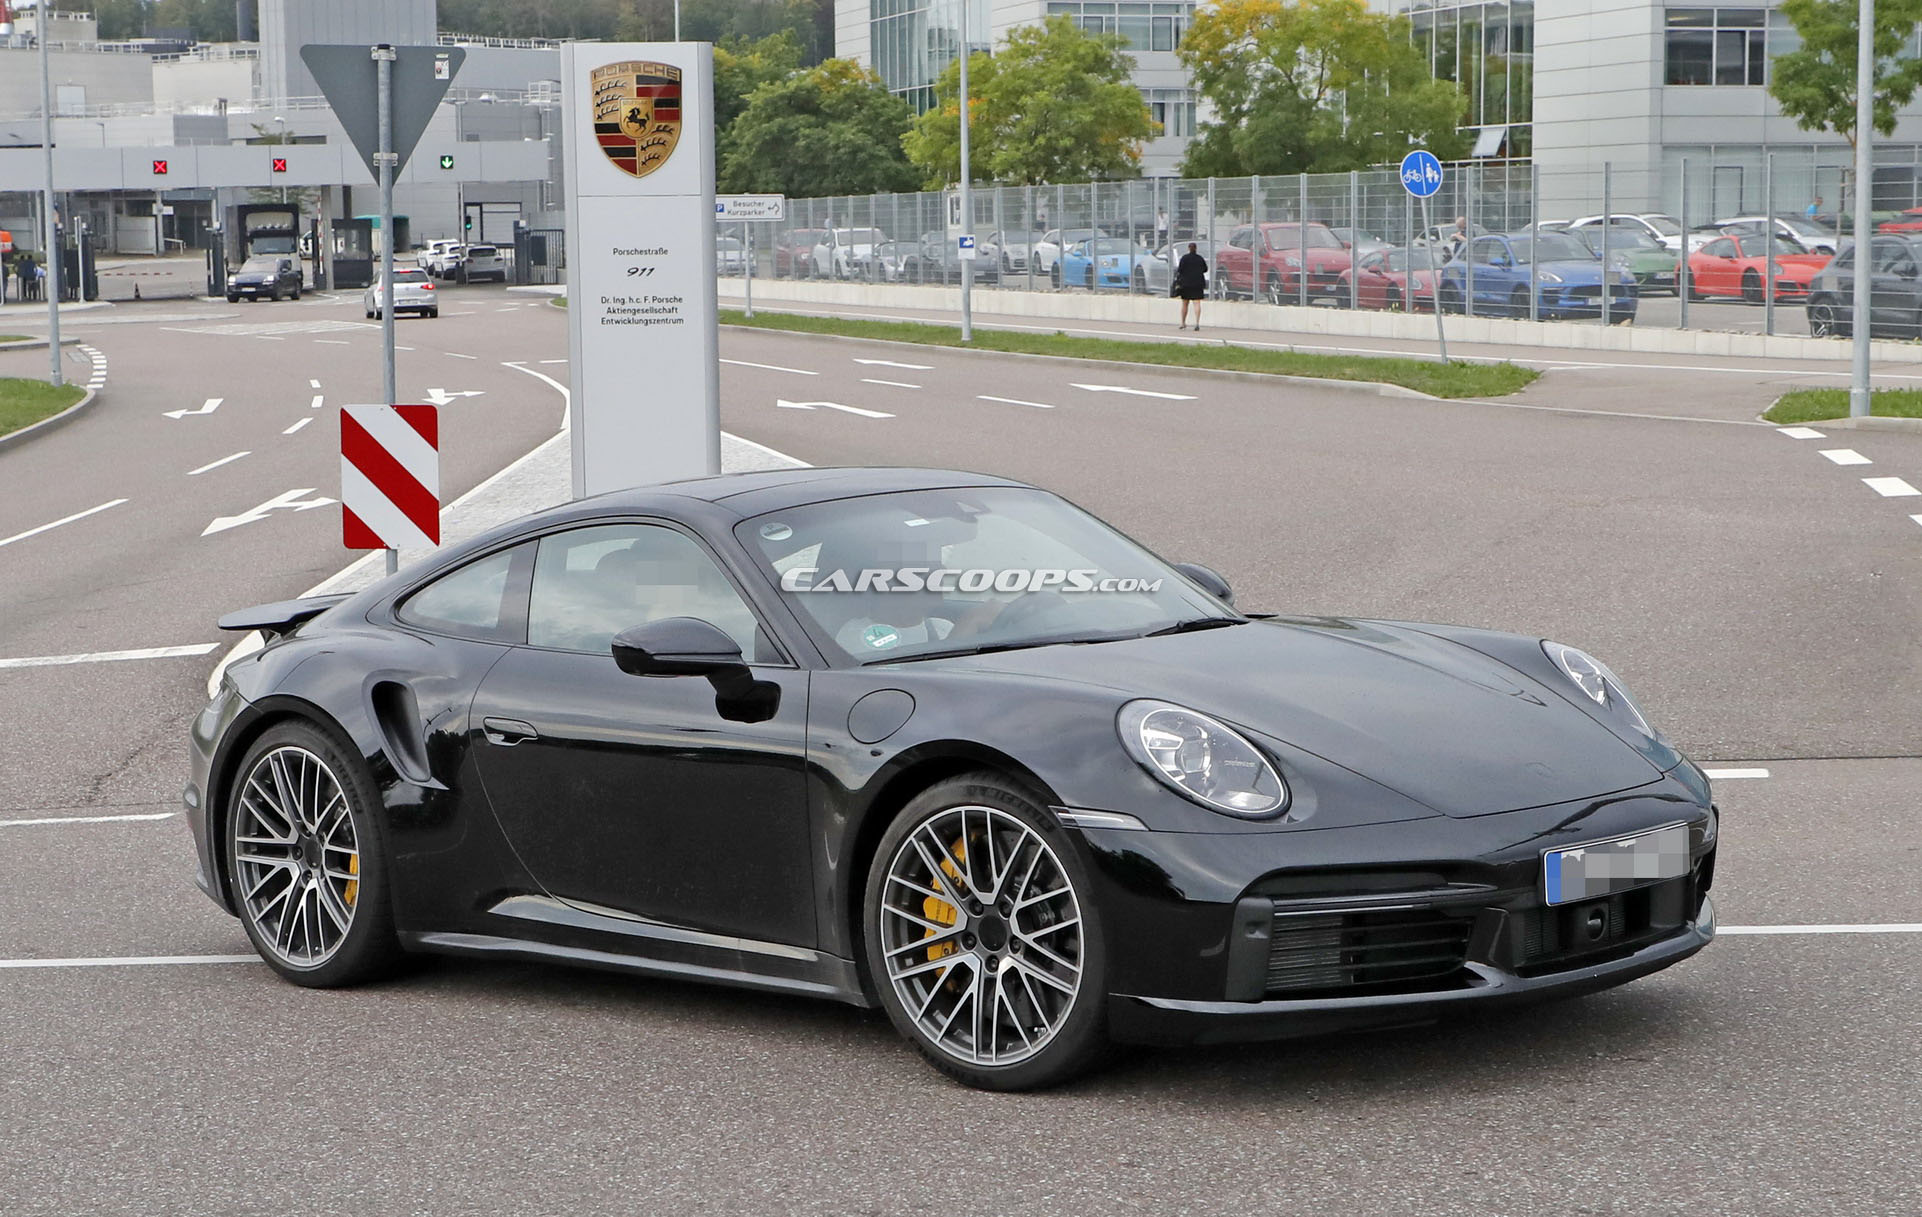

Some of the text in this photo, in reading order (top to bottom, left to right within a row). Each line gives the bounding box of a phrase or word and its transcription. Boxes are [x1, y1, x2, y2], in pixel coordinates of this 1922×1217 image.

[612, 247, 669, 256] Porschestraße
[626, 266, 655, 277] 911
[601, 296, 683, 306] Dr. Ing. h.c. F. Porsche
[606, 306, 678, 316] Aktiengesellschaft
[601, 317, 684, 327] Entwicklungszentrum
